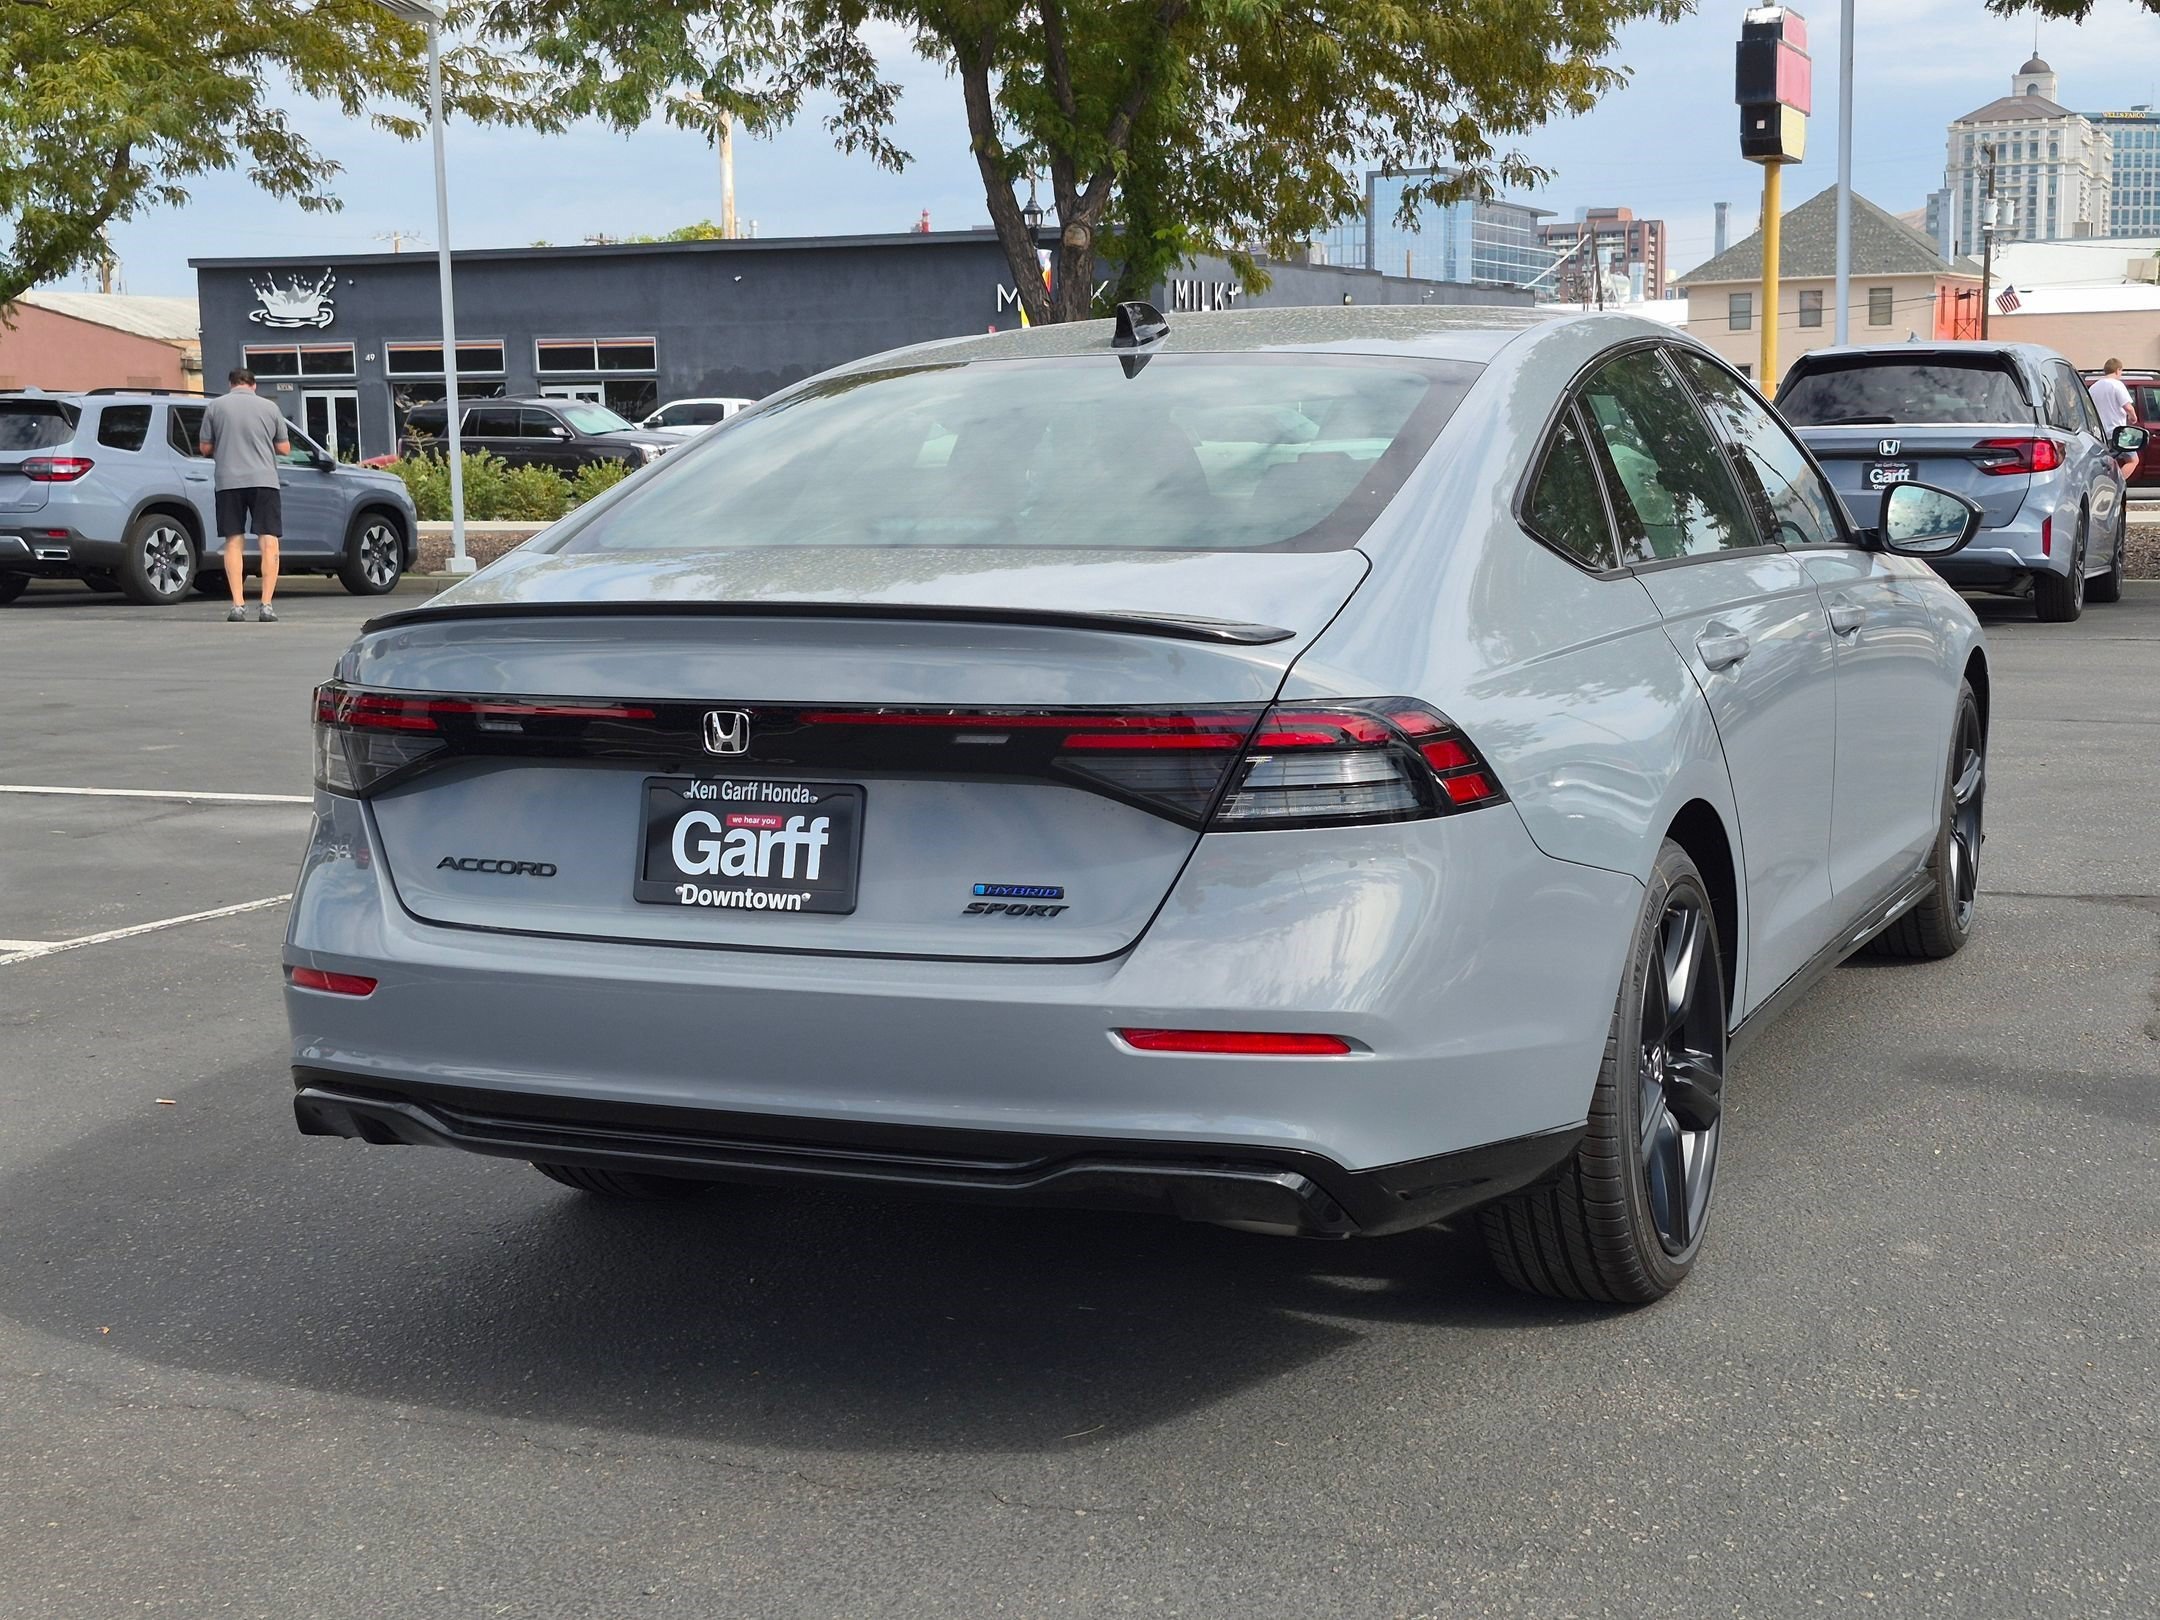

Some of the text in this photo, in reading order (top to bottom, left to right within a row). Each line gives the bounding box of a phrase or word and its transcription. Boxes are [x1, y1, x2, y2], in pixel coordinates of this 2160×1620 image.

[997, 280, 1109, 312] MK
[365, 353, 375, 361] 49
[1870, 469, 1909, 483] Garff
[690, 780, 809, 803] Ken Garff Honda
[744, 817, 759, 825] hear
[672, 811, 830, 880] Garff
[436, 856, 557, 877] ACCORD
[681, 884, 801, 910] Downtown
[987, 886, 1058, 897] HYBRID
[963, 902, 1070, 917] SPORT
